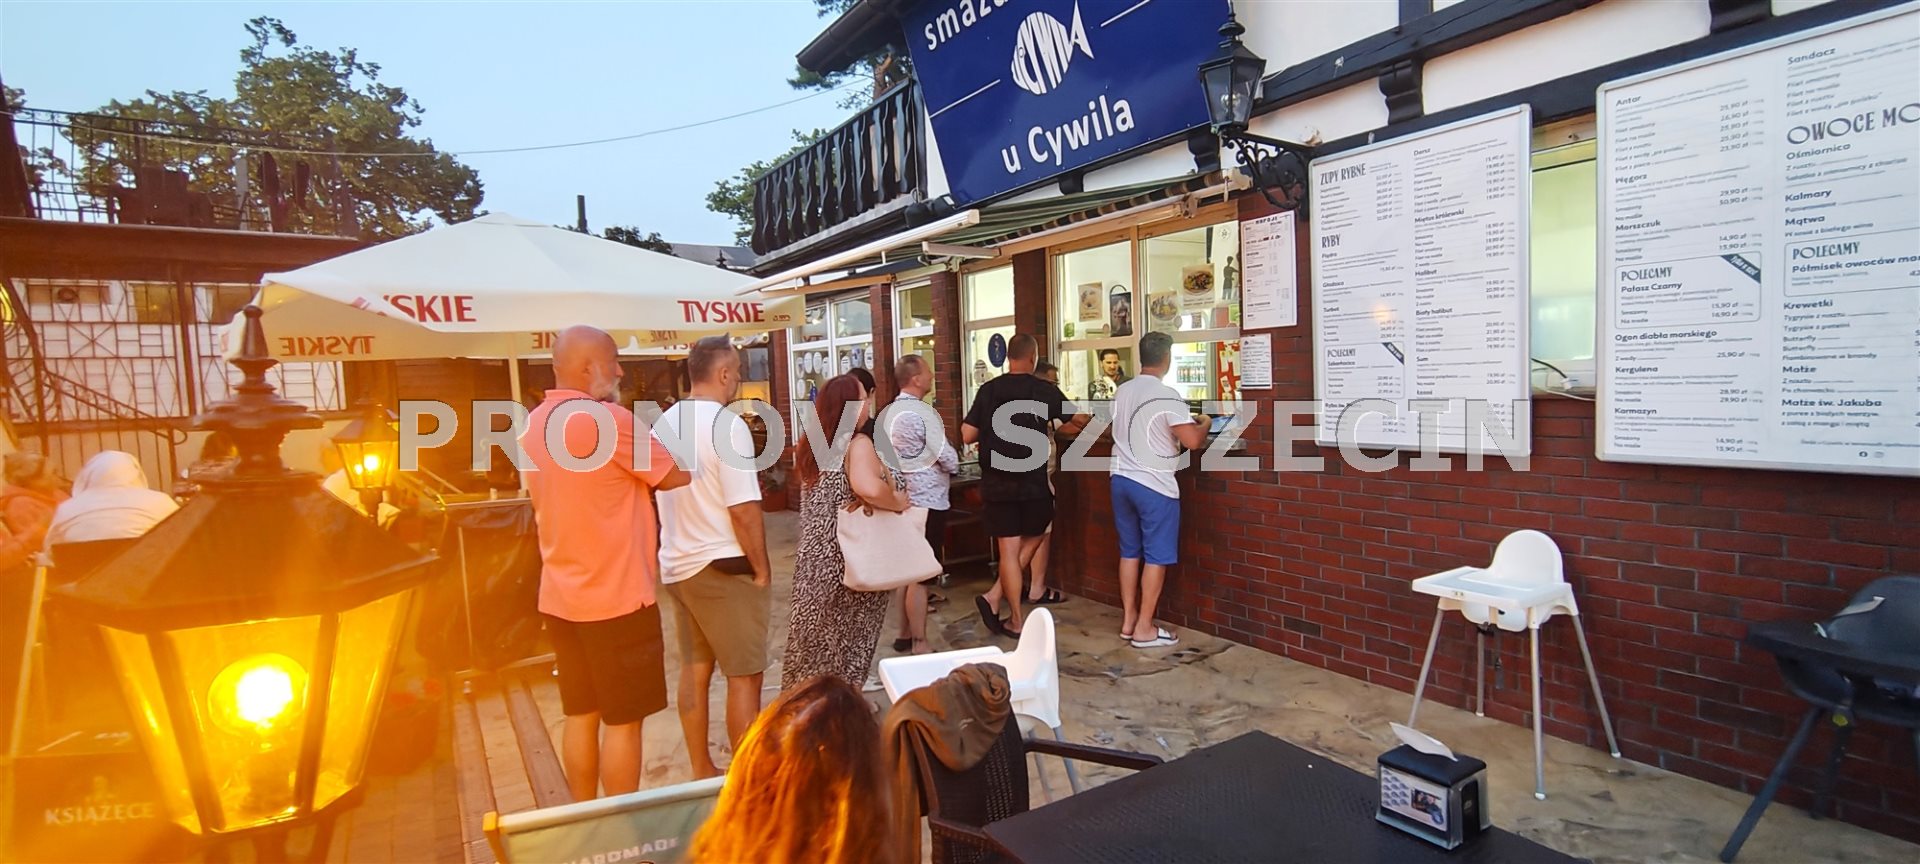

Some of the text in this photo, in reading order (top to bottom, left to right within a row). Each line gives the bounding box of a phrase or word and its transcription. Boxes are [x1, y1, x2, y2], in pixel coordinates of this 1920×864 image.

[1787, 48, 1836, 65] Sandacz
[1002, 95, 1135, 173] u Cywila
[1787, 111, 1875, 144] OWOCE
[1786, 143, 1851, 160] Ośmiornica
[1320, 169, 1339, 186] ZUPY
[1341, 163, 1367, 181] RYBNE
[1615, 174, 1647, 185] Węgorz
[1785, 190, 1832, 202] Kalmary
[1615, 219, 1661, 232] Morszczuk
[1785, 216, 1825, 226] Mątwa
[1322, 234, 1341, 249] RYBY
[1792, 241, 1861, 260] POLECAMY
[1792, 261, 1843, 273] Półmisek
[1845, 257, 1896, 268] owoców
[1415, 269, 1438, 277] Halibut
[1621, 266, 1672, 281] POLECAMY
[1621, 282, 1682, 293] Pałasz Czarny
[1783, 299, 1833, 309] Krewetki
[677, 300, 765, 323] TYSKIE
[1615, 330, 1718, 342] Ogon diabła morskiego
[1615, 366, 1658, 374] Kergulena
[1782, 365, 1817, 373] Małże
